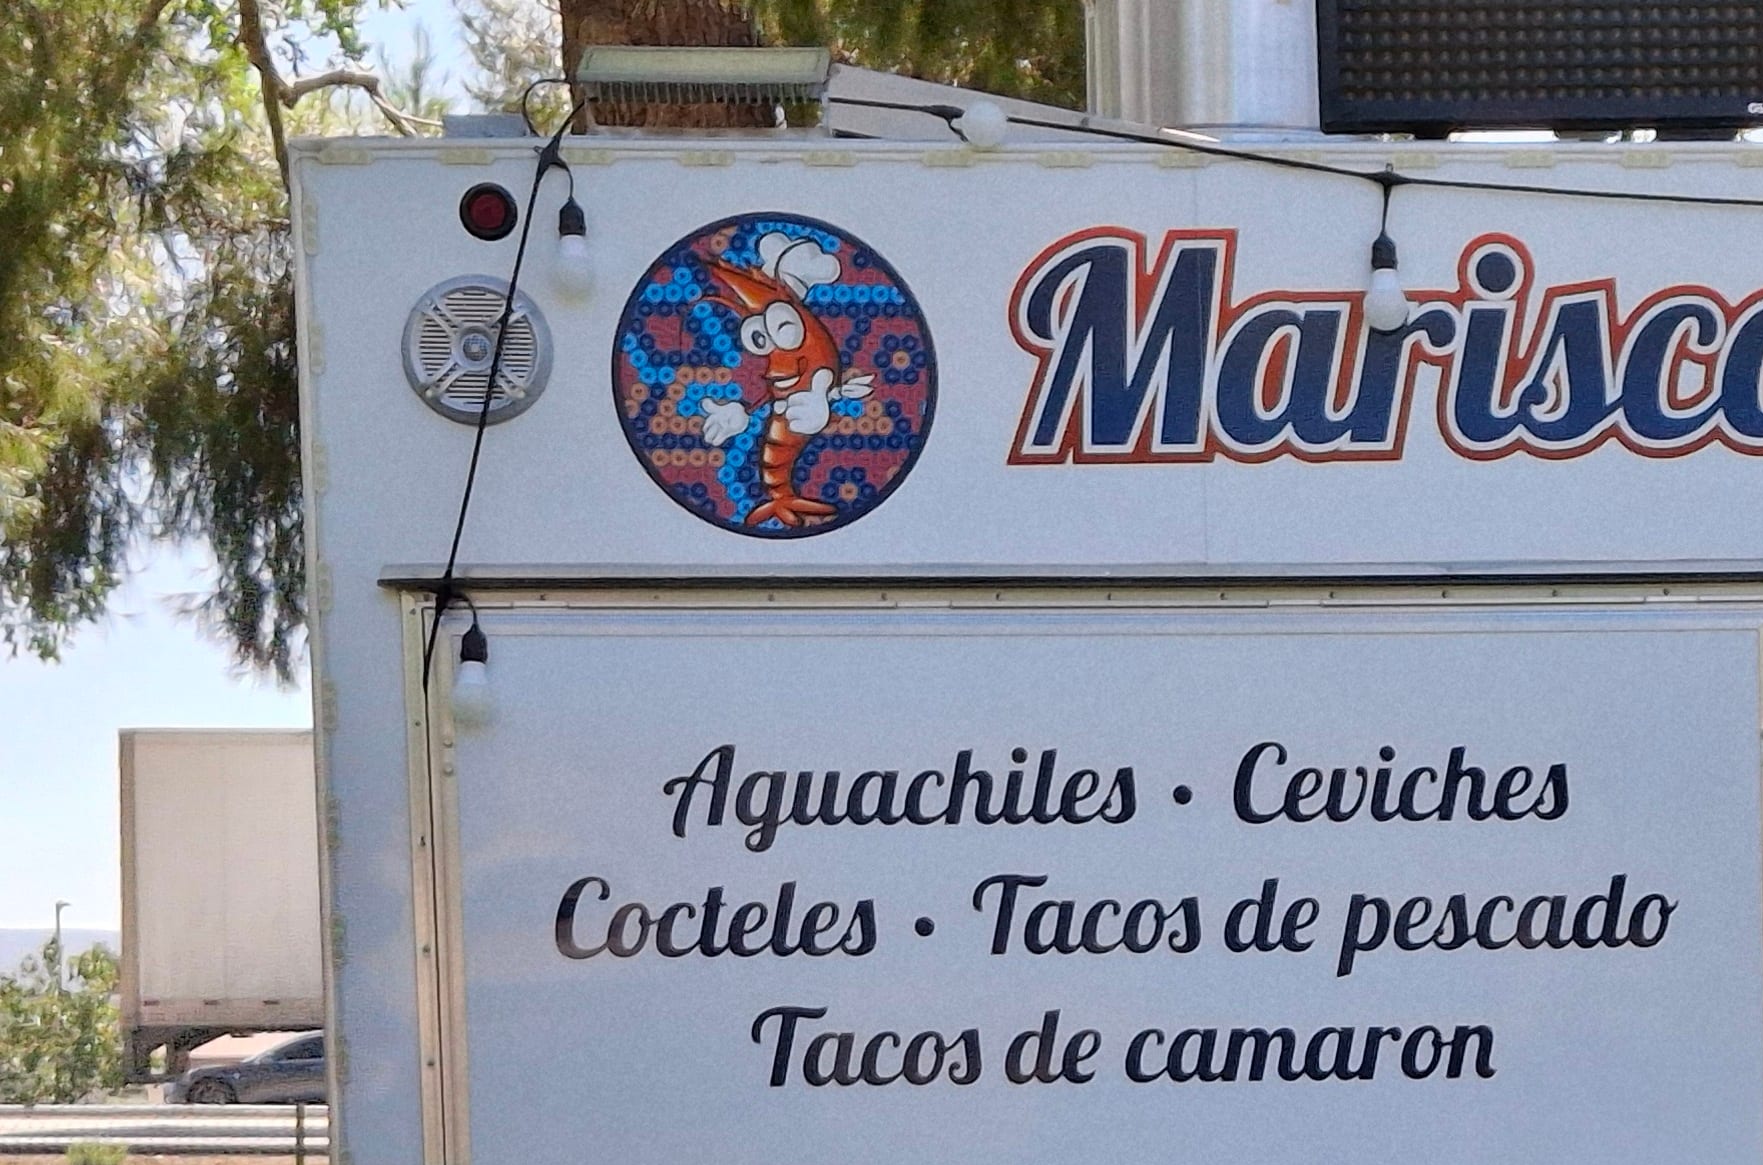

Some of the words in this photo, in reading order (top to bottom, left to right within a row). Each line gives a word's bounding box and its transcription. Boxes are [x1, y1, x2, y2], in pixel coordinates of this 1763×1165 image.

[663, 744, 1136, 853] Aguachiles
[1233, 742, 1569, 824] Ceviches
[555, 876, 877, 960] Cocteles
[973, 874, 1201, 955] Tacos
[1224, 878, 1319, 953] de
[1337, 873, 1679, 977] pescado
[751, 1006, 982, 1087] Tacos
[1005, 1009, 1101, 1085] de
[1125, 1025, 1497, 1083] camaron
